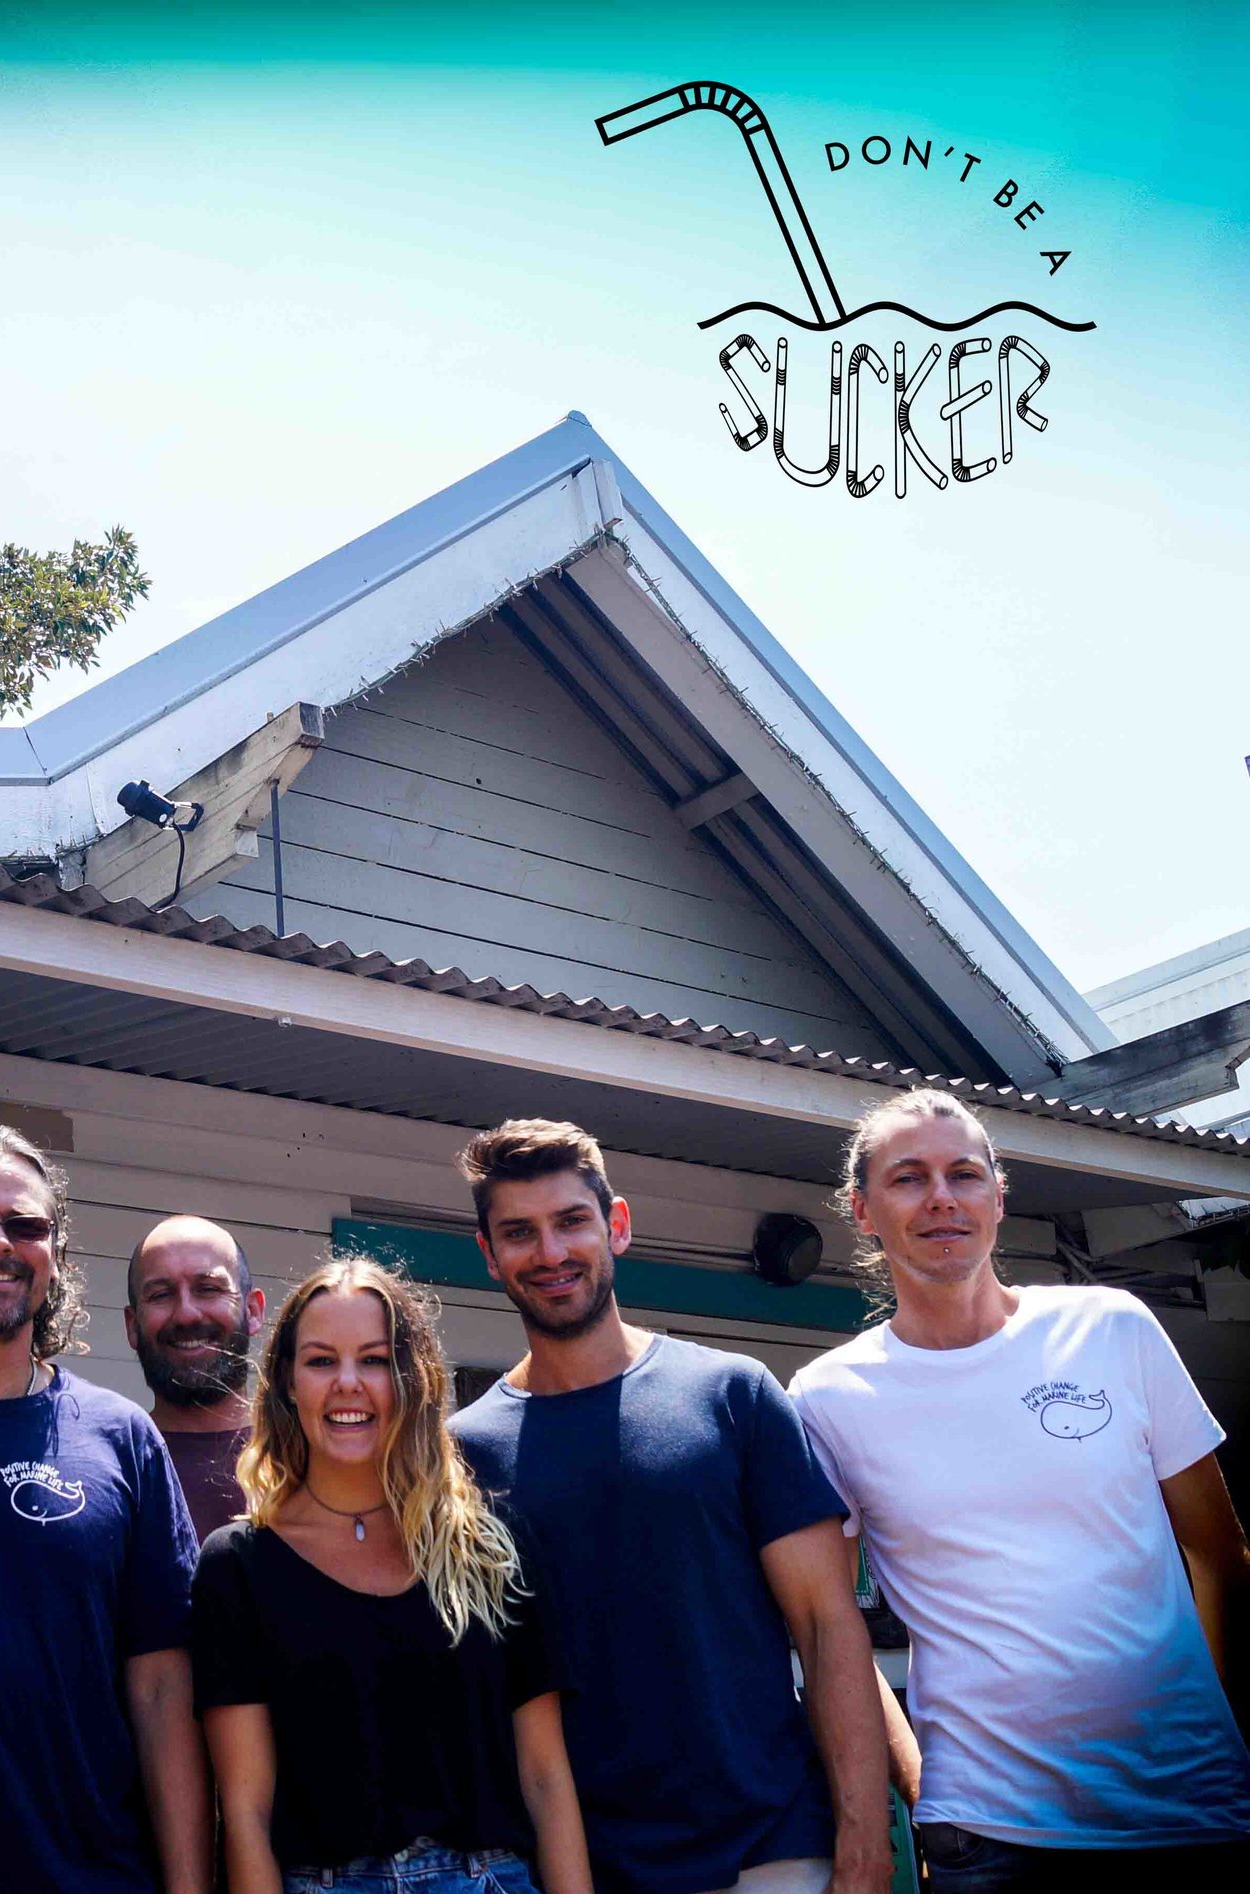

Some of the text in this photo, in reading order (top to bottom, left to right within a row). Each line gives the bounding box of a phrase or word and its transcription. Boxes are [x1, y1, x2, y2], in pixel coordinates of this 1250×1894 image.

[1020, 1381, 1079, 1404] POSITIVE CHANGE
[1027, 1390, 1087, 1413] FOR MARINE LIFE
[0, 1461, 60, 1478] POSITIVE CHANGE
[20, 1470, 48, 1482] MARINE
[48, 1477, 64, 1490] LIFE
